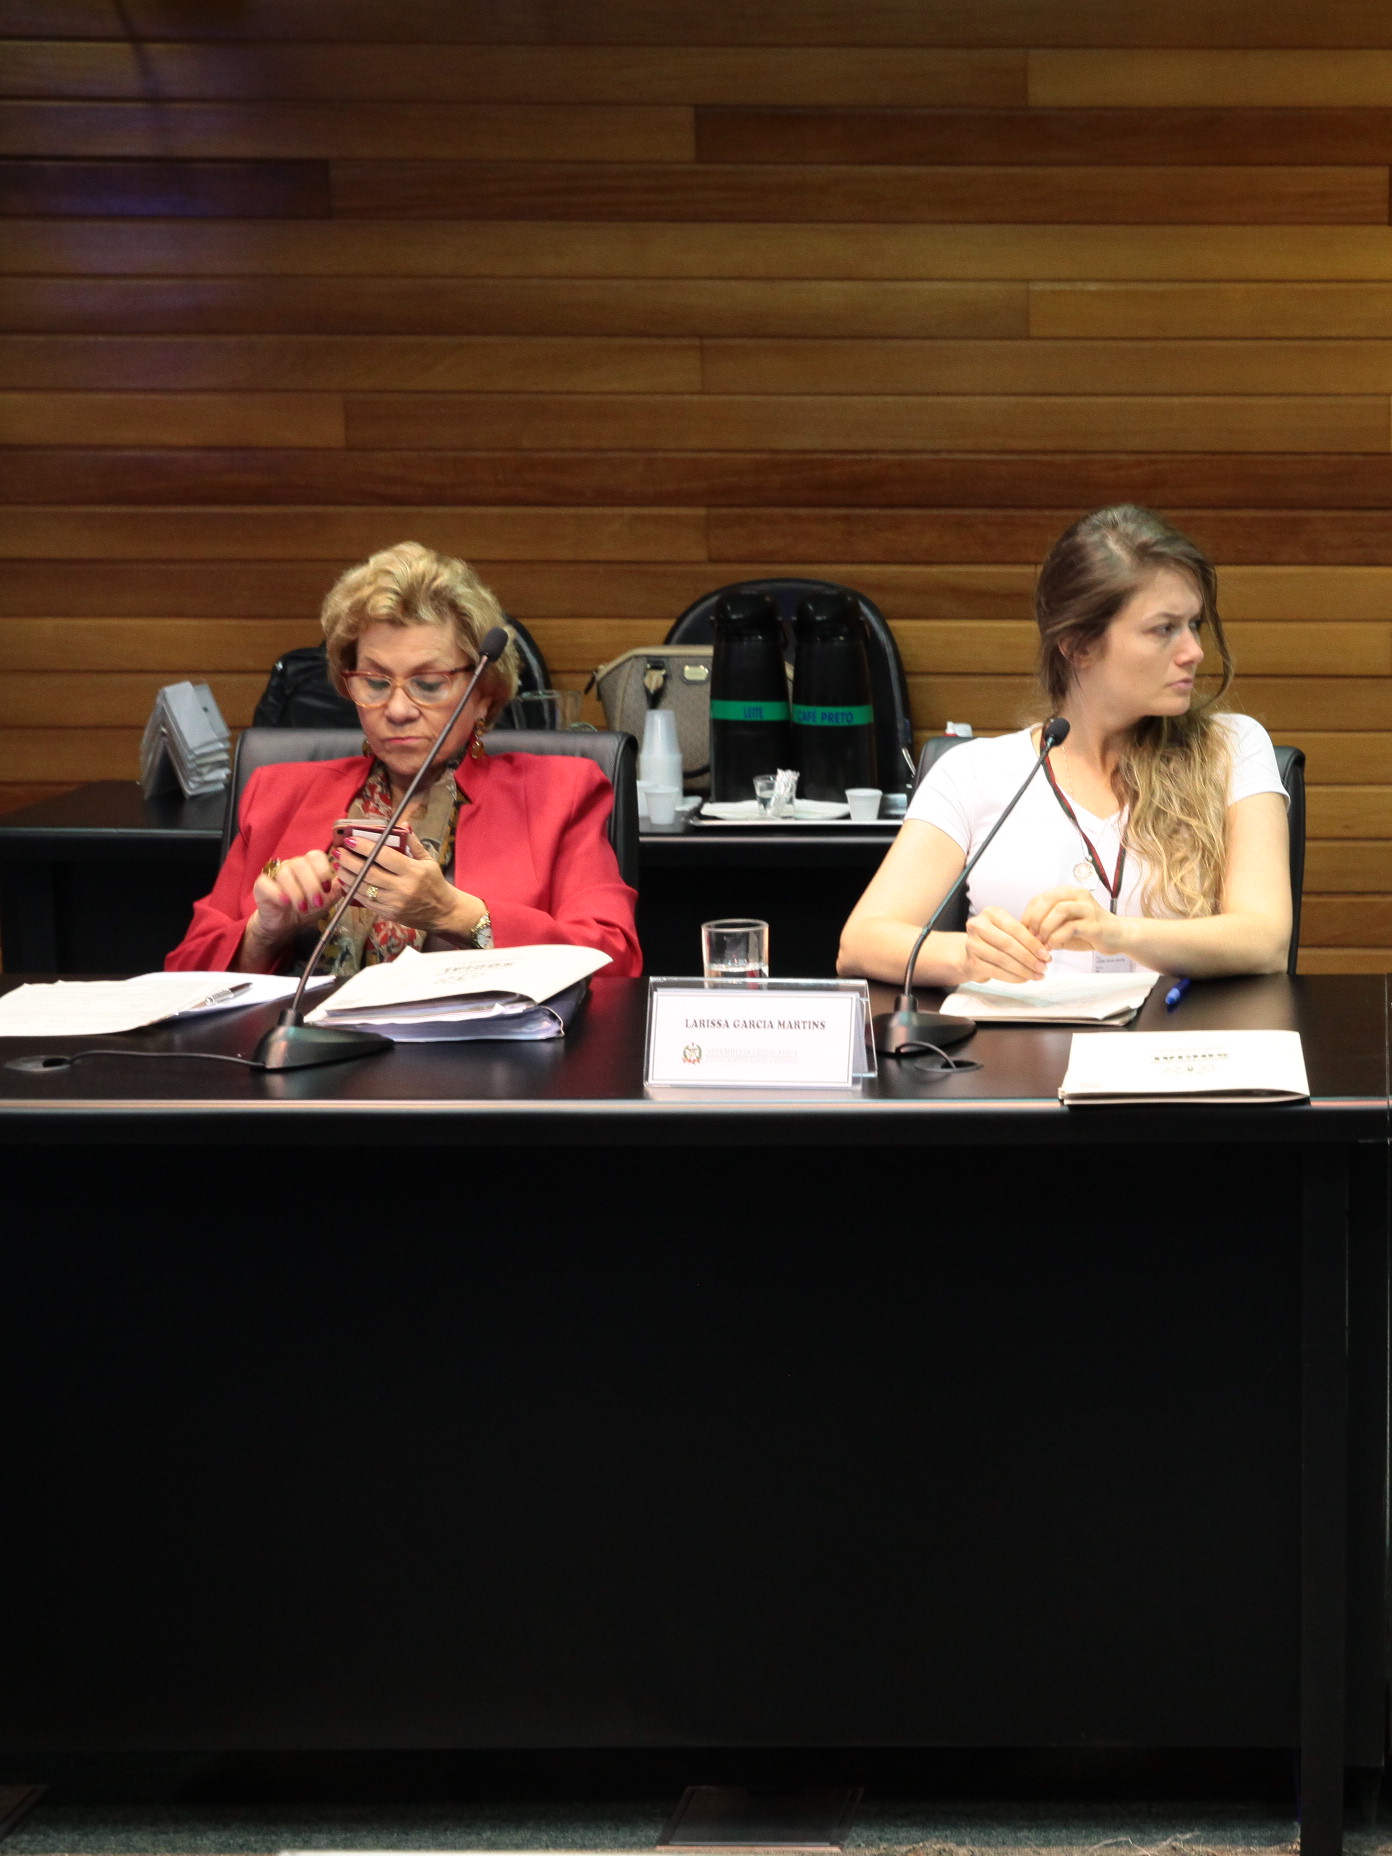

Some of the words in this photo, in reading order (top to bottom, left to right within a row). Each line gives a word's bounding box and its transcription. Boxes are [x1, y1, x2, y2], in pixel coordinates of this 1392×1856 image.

[744, 706, 764, 719] LEITE
[798, 709, 817, 723] CAFÉ
[821, 711, 854, 724] PRETO
[685, 1018, 730, 1029] LARISSA
[733, 1019, 774, 1030] GARCIA
[777, 1019, 826, 1030] MARTINS
